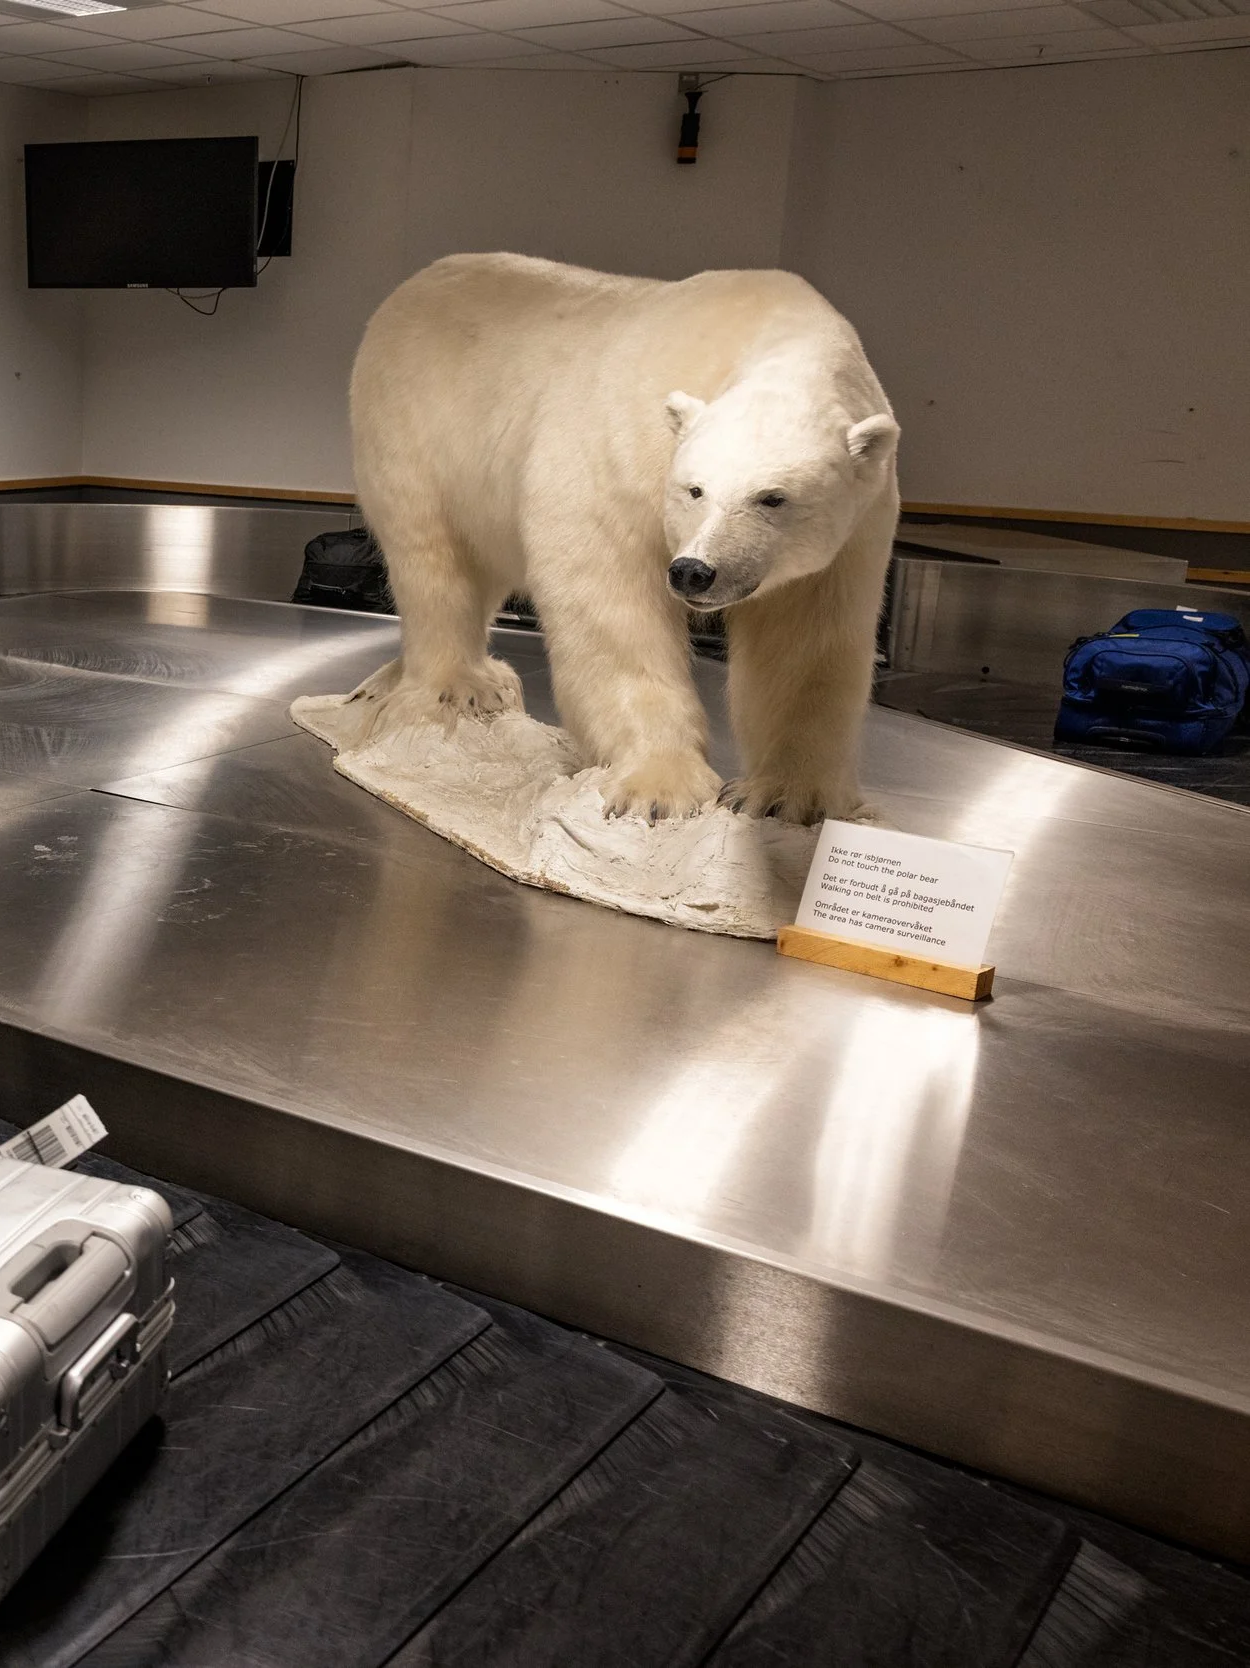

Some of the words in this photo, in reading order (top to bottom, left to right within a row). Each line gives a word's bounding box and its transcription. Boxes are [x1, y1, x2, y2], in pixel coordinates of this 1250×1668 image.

[828, 855, 840, 863] Do
[841, 859, 855, 867] not
[856, 861, 879, 872] touch
[881, 866, 895, 875] the
[896, 870, 918, 880] polar
[919, 874, 939, 884] bear
[830, 846, 848, 856] Ikke
[850, 851, 863, 859] rør
[864, 853, 902, 867] isbjørnen
[820, 881, 852, 897] Walking
[853, 890, 864, 898] on
[865, 892, 881, 902] belt
[883, 896, 891, 904] is
[892, 899, 934, 913] prohibited
[822, 873, 837, 883] Det
[850, 879, 879, 892] forbudt
[880, 884, 887, 893] å
[888, 886, 899, 896] gå
[900, 889, 911, 899] på
[913, 892, 975, 912] bagasjebåndet
[813, 908, 827, 919] The
[828, 913, 847, 923] area
[848, 918, 863, 927] has
[864, 922, 895, 935] camera
[896, 930, 947, 946] surveillance
[815, 900, 850, 914] Området
[862, 911, 933, 933] kameraovervåket
